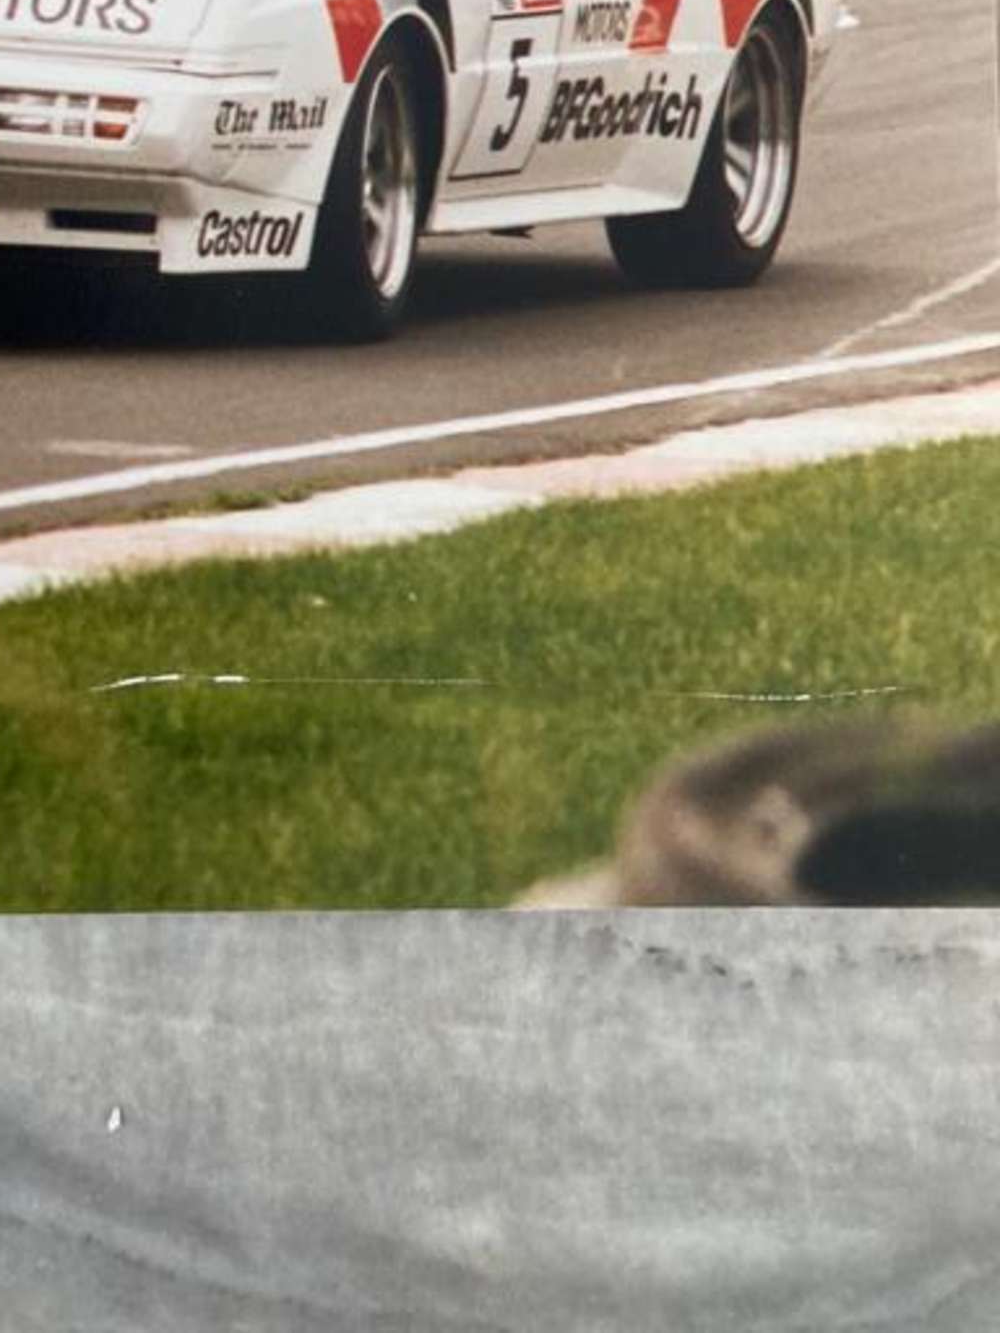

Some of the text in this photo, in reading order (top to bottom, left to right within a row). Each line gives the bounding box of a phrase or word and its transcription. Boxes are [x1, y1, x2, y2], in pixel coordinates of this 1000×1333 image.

[214, 95, 328, 136] The Mail
[490, 37, 534, 152] 5
[538, 71, 702, 144] BFGoodrich
[198, 210, 304, 257] Castrol
